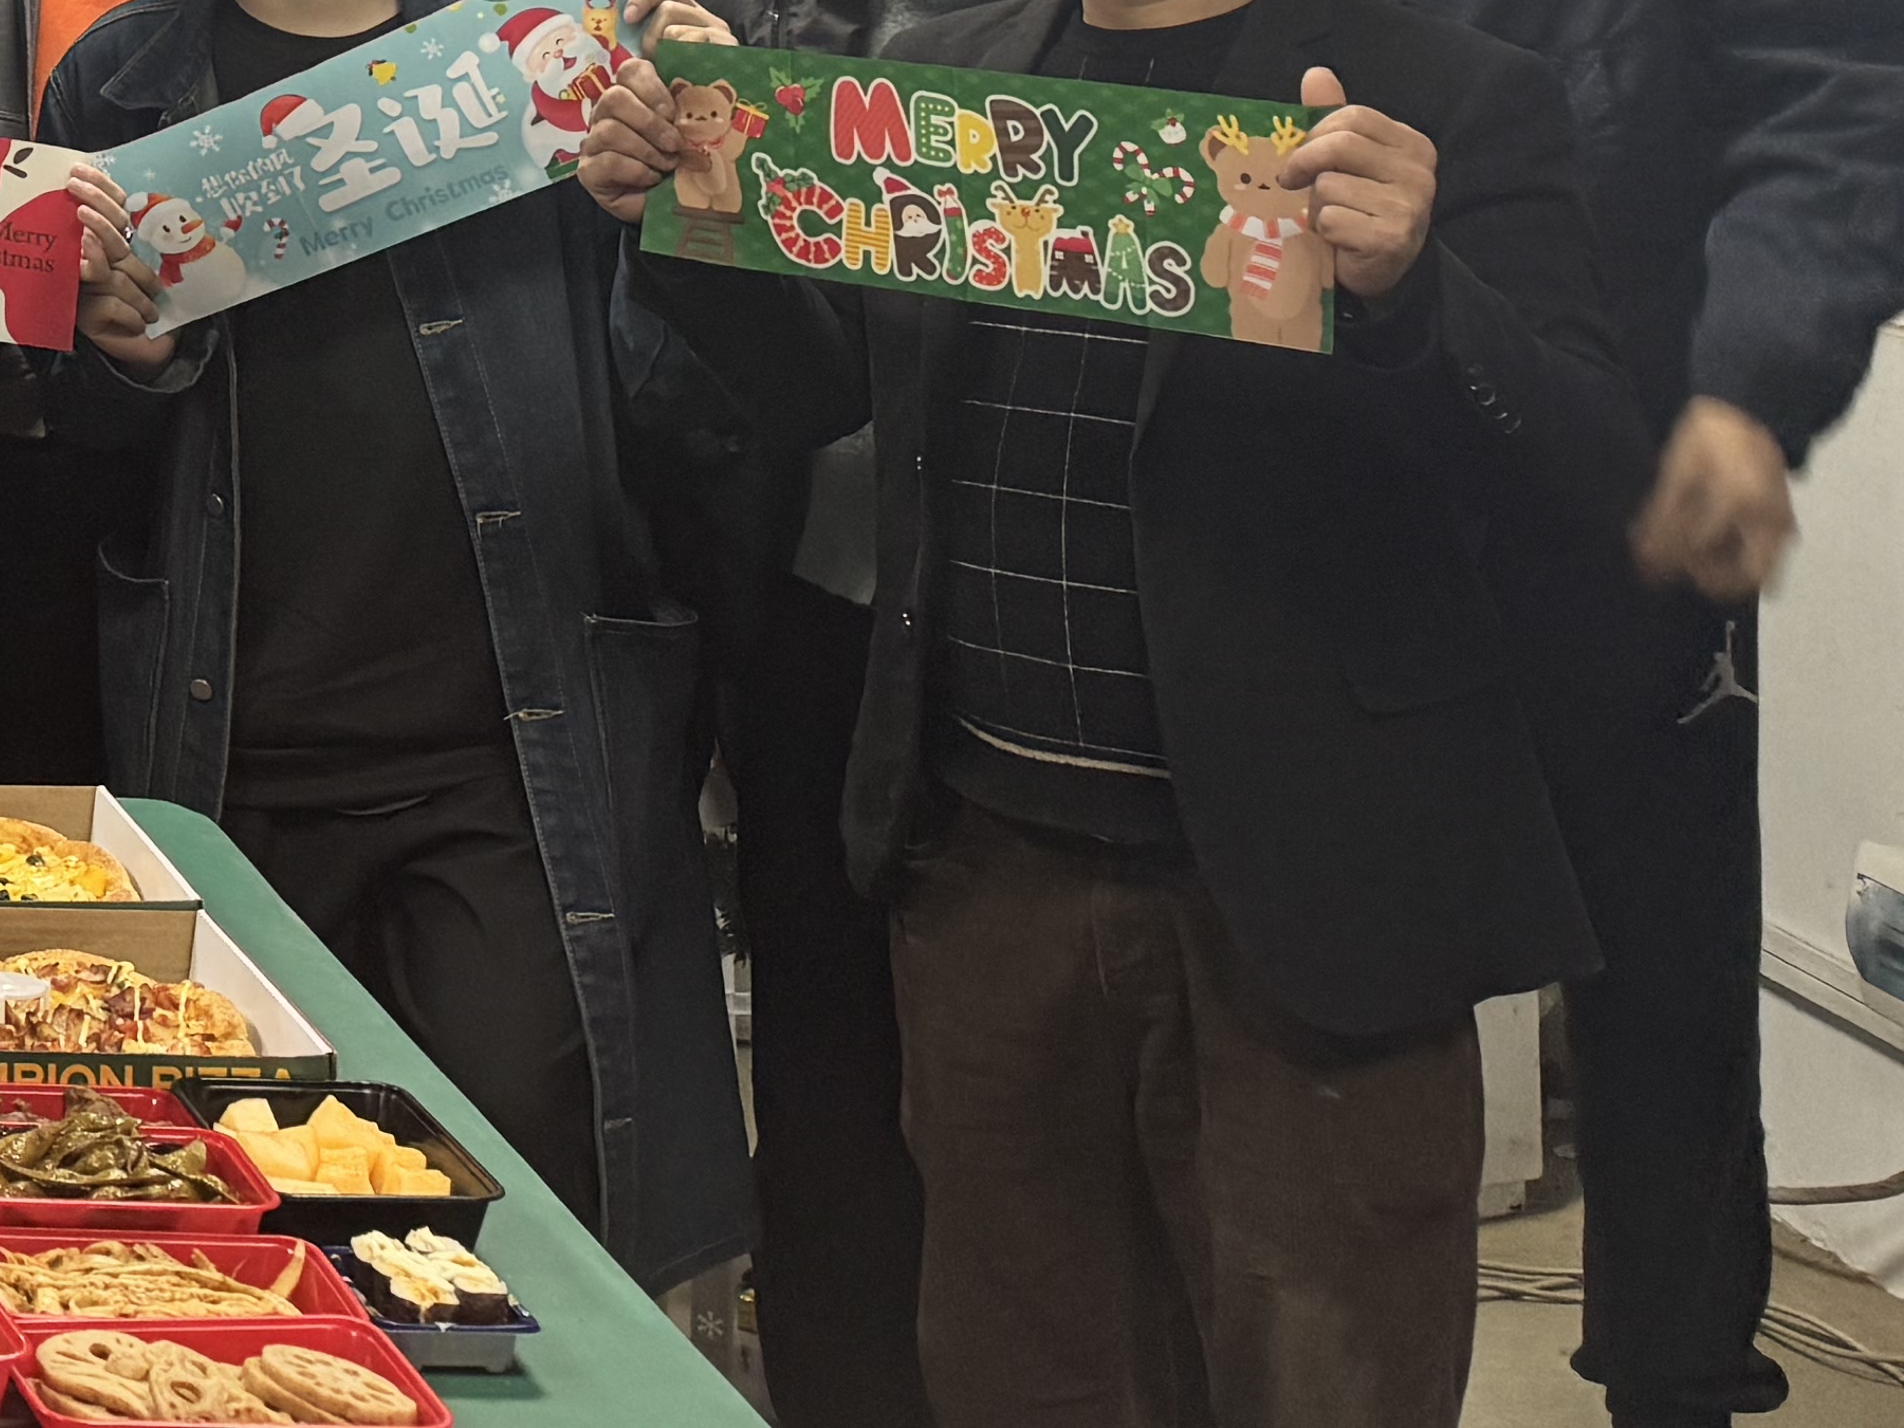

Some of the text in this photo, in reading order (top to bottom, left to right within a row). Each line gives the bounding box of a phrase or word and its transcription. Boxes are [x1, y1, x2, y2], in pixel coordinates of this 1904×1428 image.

[275, 50, 508, 212] 圣诞
[830, 76, 1098, 187] MERRY
[299, 162, 510, 257] Merry Christmas
[752, 154, 1196, 318] CHRISTMAS
